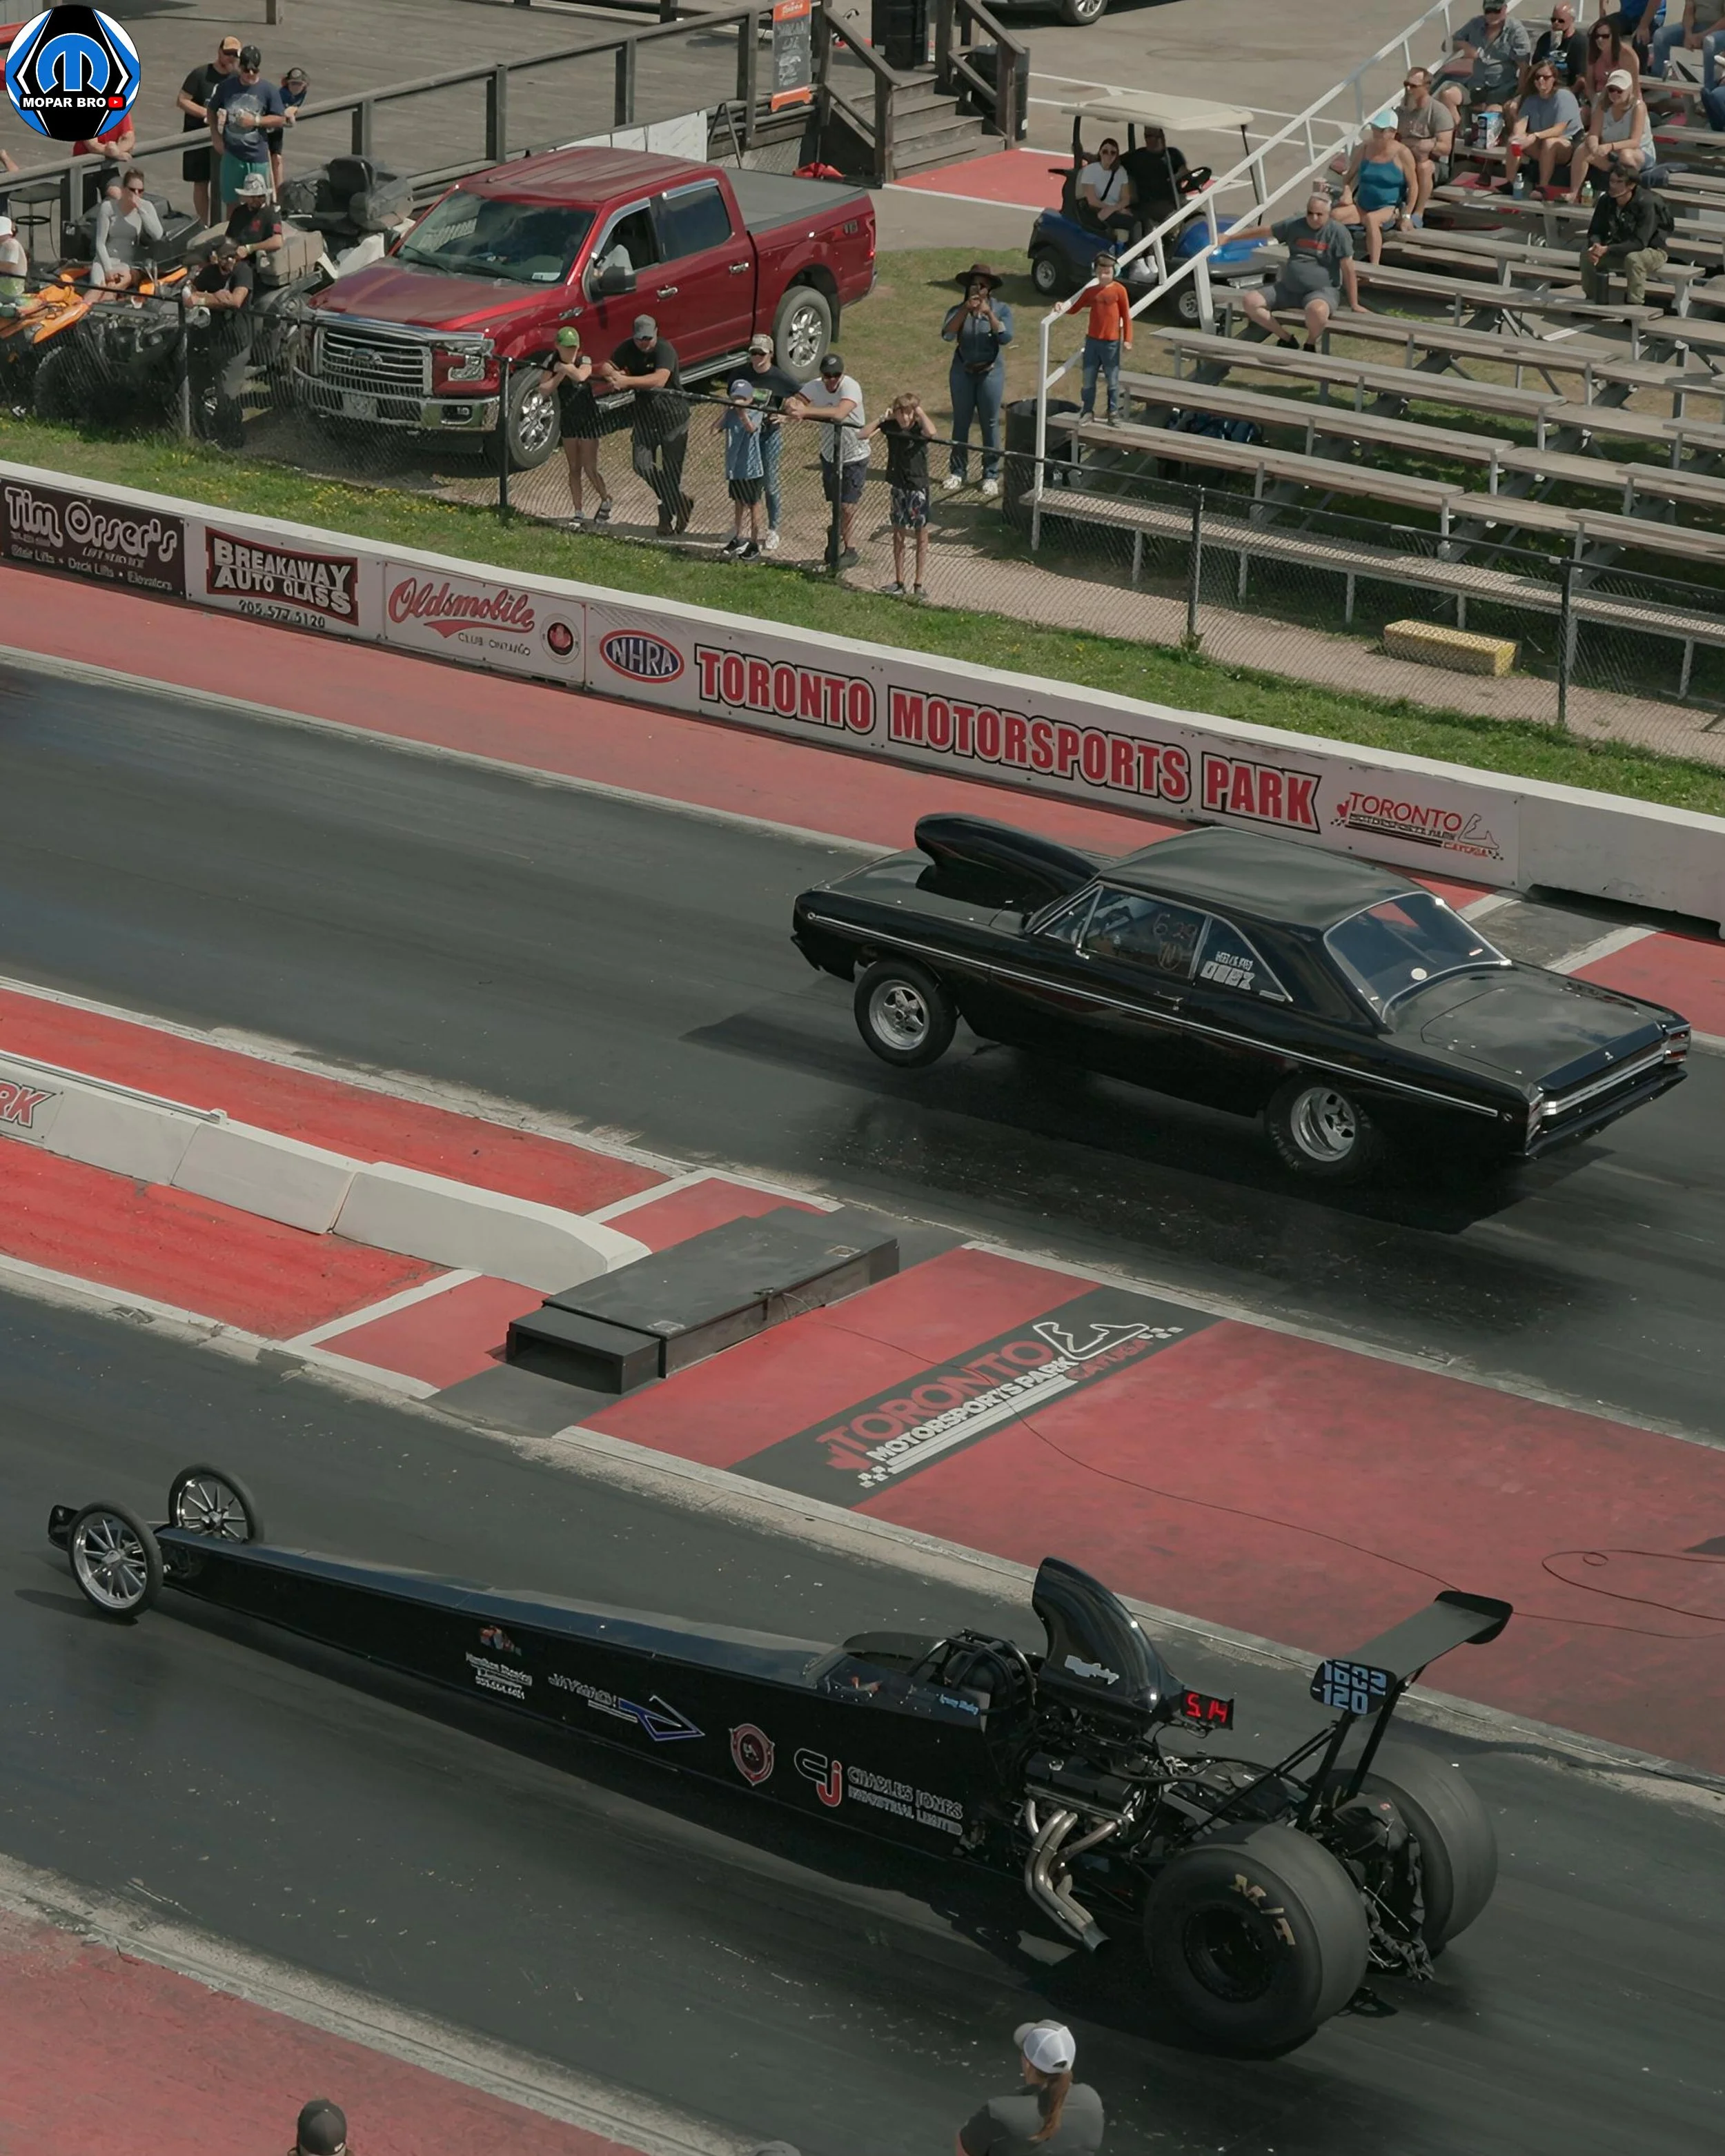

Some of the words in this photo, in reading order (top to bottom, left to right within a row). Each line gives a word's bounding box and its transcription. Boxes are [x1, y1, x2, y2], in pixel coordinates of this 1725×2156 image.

[5, 486, 63, 547] Tim
[65, 501, 177, 563] Orser's
[214, 537, 351, 593] BREAKAWAY
[214, 565, 275, 593] AUTO
[283, 579, 352, 615] GLASS
[388, 577, 535, 627] Oldsmobile
[457, 633, 484, 646] CLUB
[611, 639, 679, 676] NHRA
[695, 643, 876, 735] TORONTO
[888, 685, 1192, 803] MOTORSPORTS
[1201, 751, 1322, 834] PARK
[1350, 792, 1462, 832] TORONTO
[816, 1340, 1054, 1447] TORONTO
[866, 1381, 1024, 1461] MOTORSPORTS
[1014, 1357, 1078, 1395] PARK
[1186, 1693, 1228, 1723] 5.14
